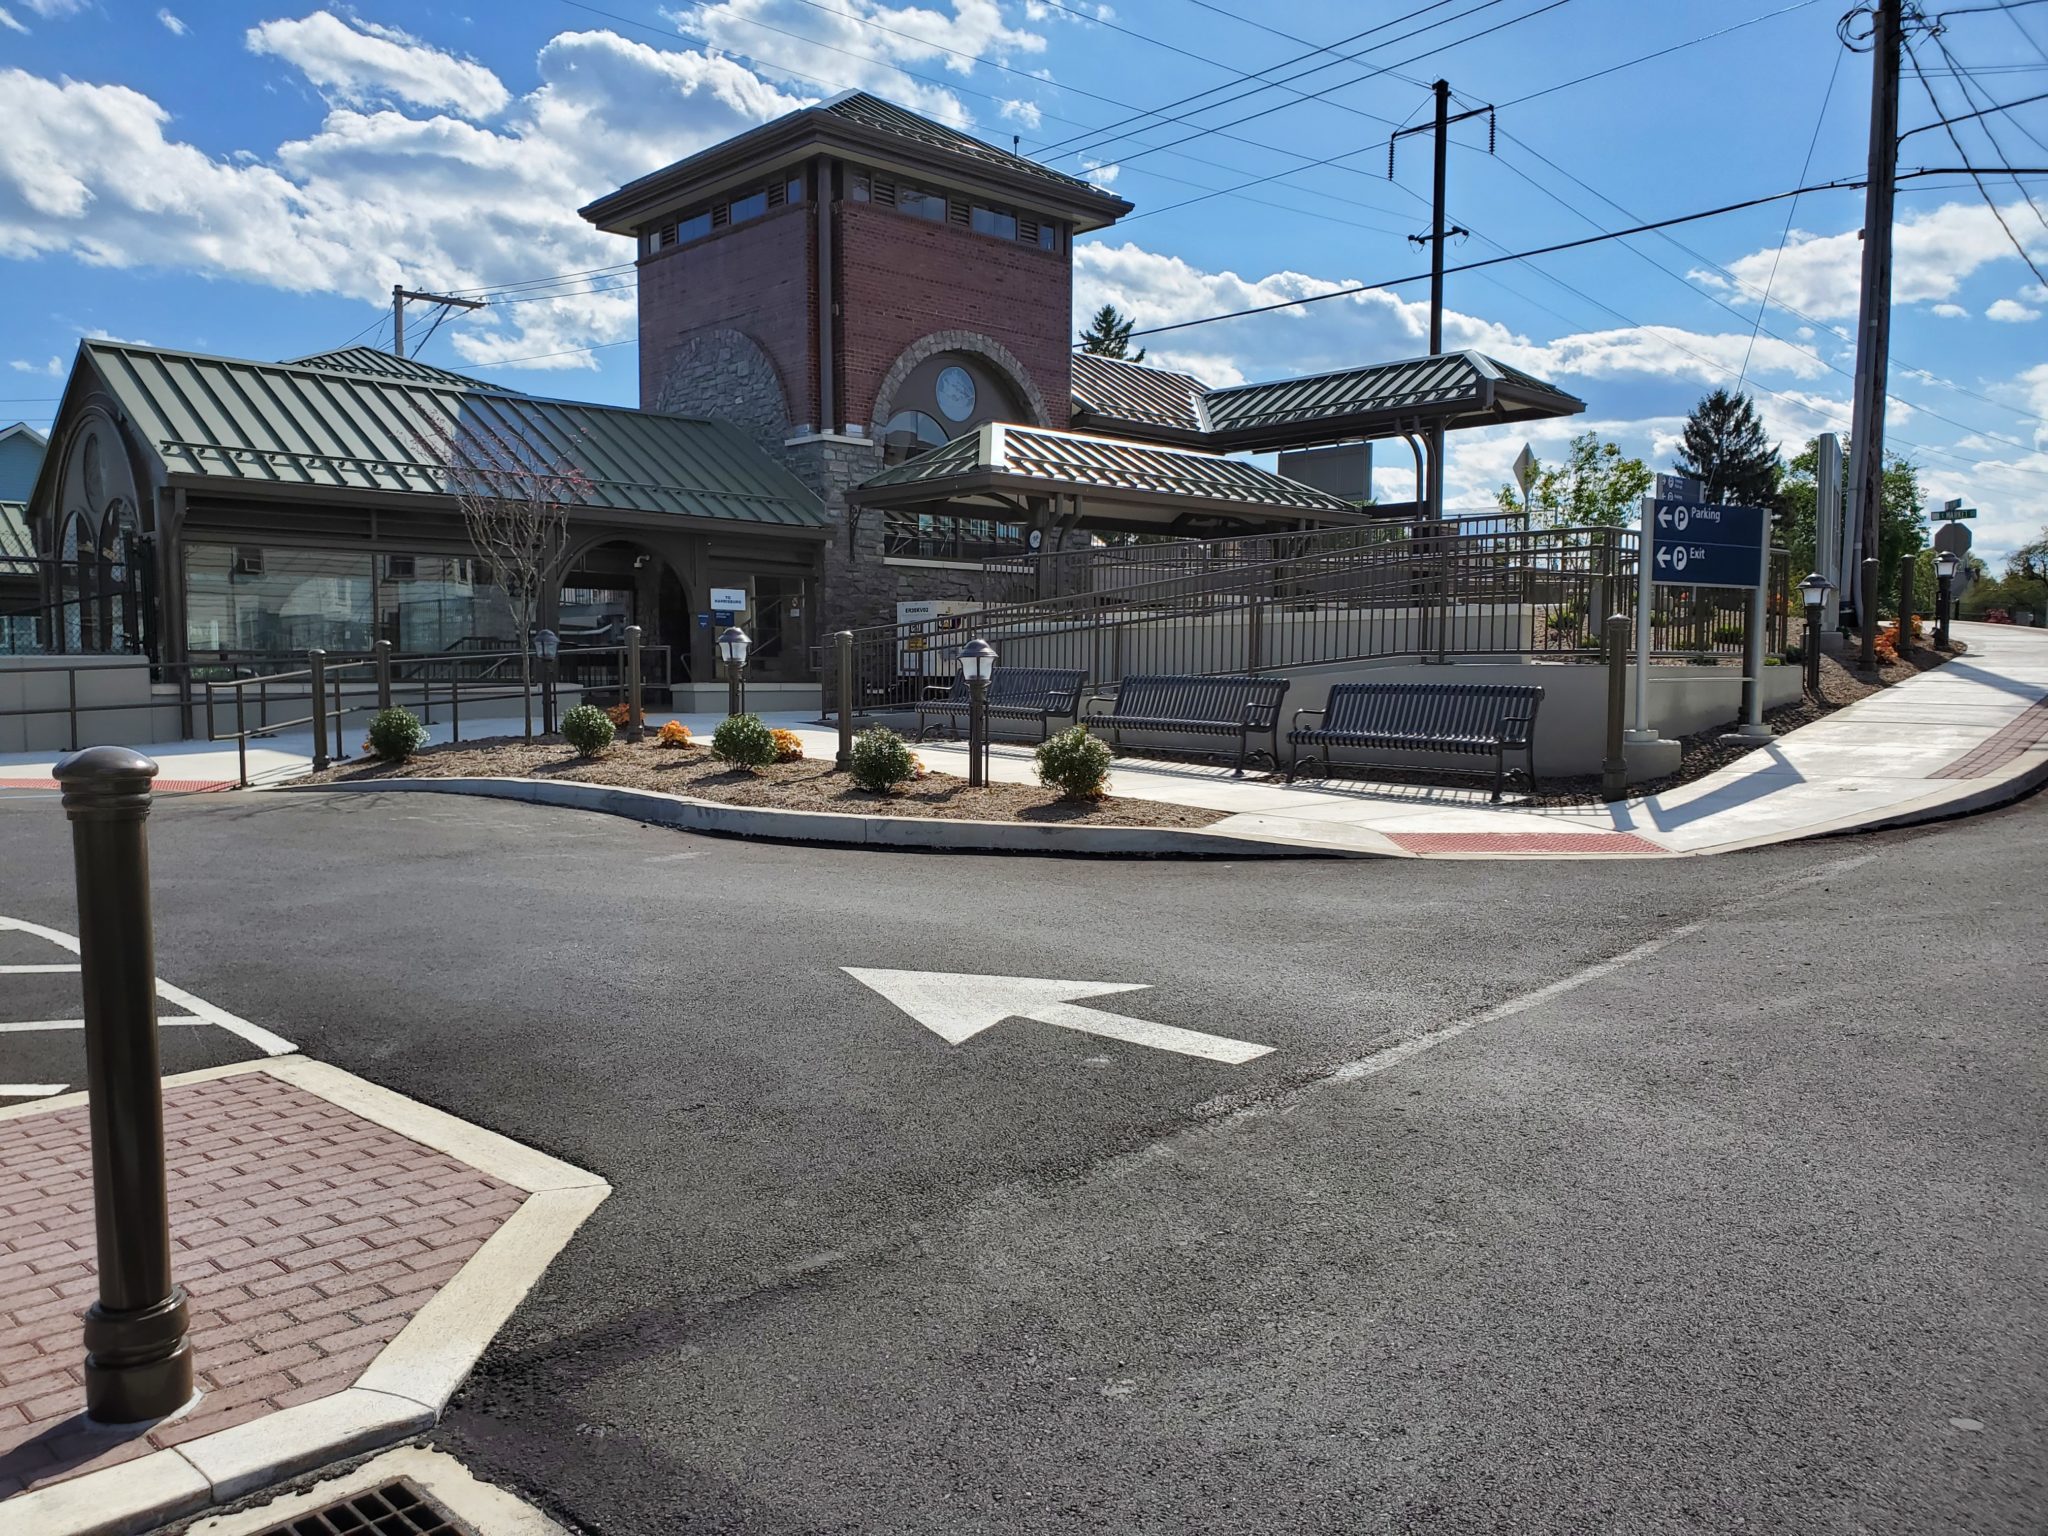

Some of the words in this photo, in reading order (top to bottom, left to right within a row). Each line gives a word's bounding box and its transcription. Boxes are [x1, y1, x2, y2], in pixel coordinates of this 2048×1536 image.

[1691, 506, 1721, 523] Parking
[1946, 510, 1968, 519] MARKET
[1689, 547, 1705, 560] Exit
